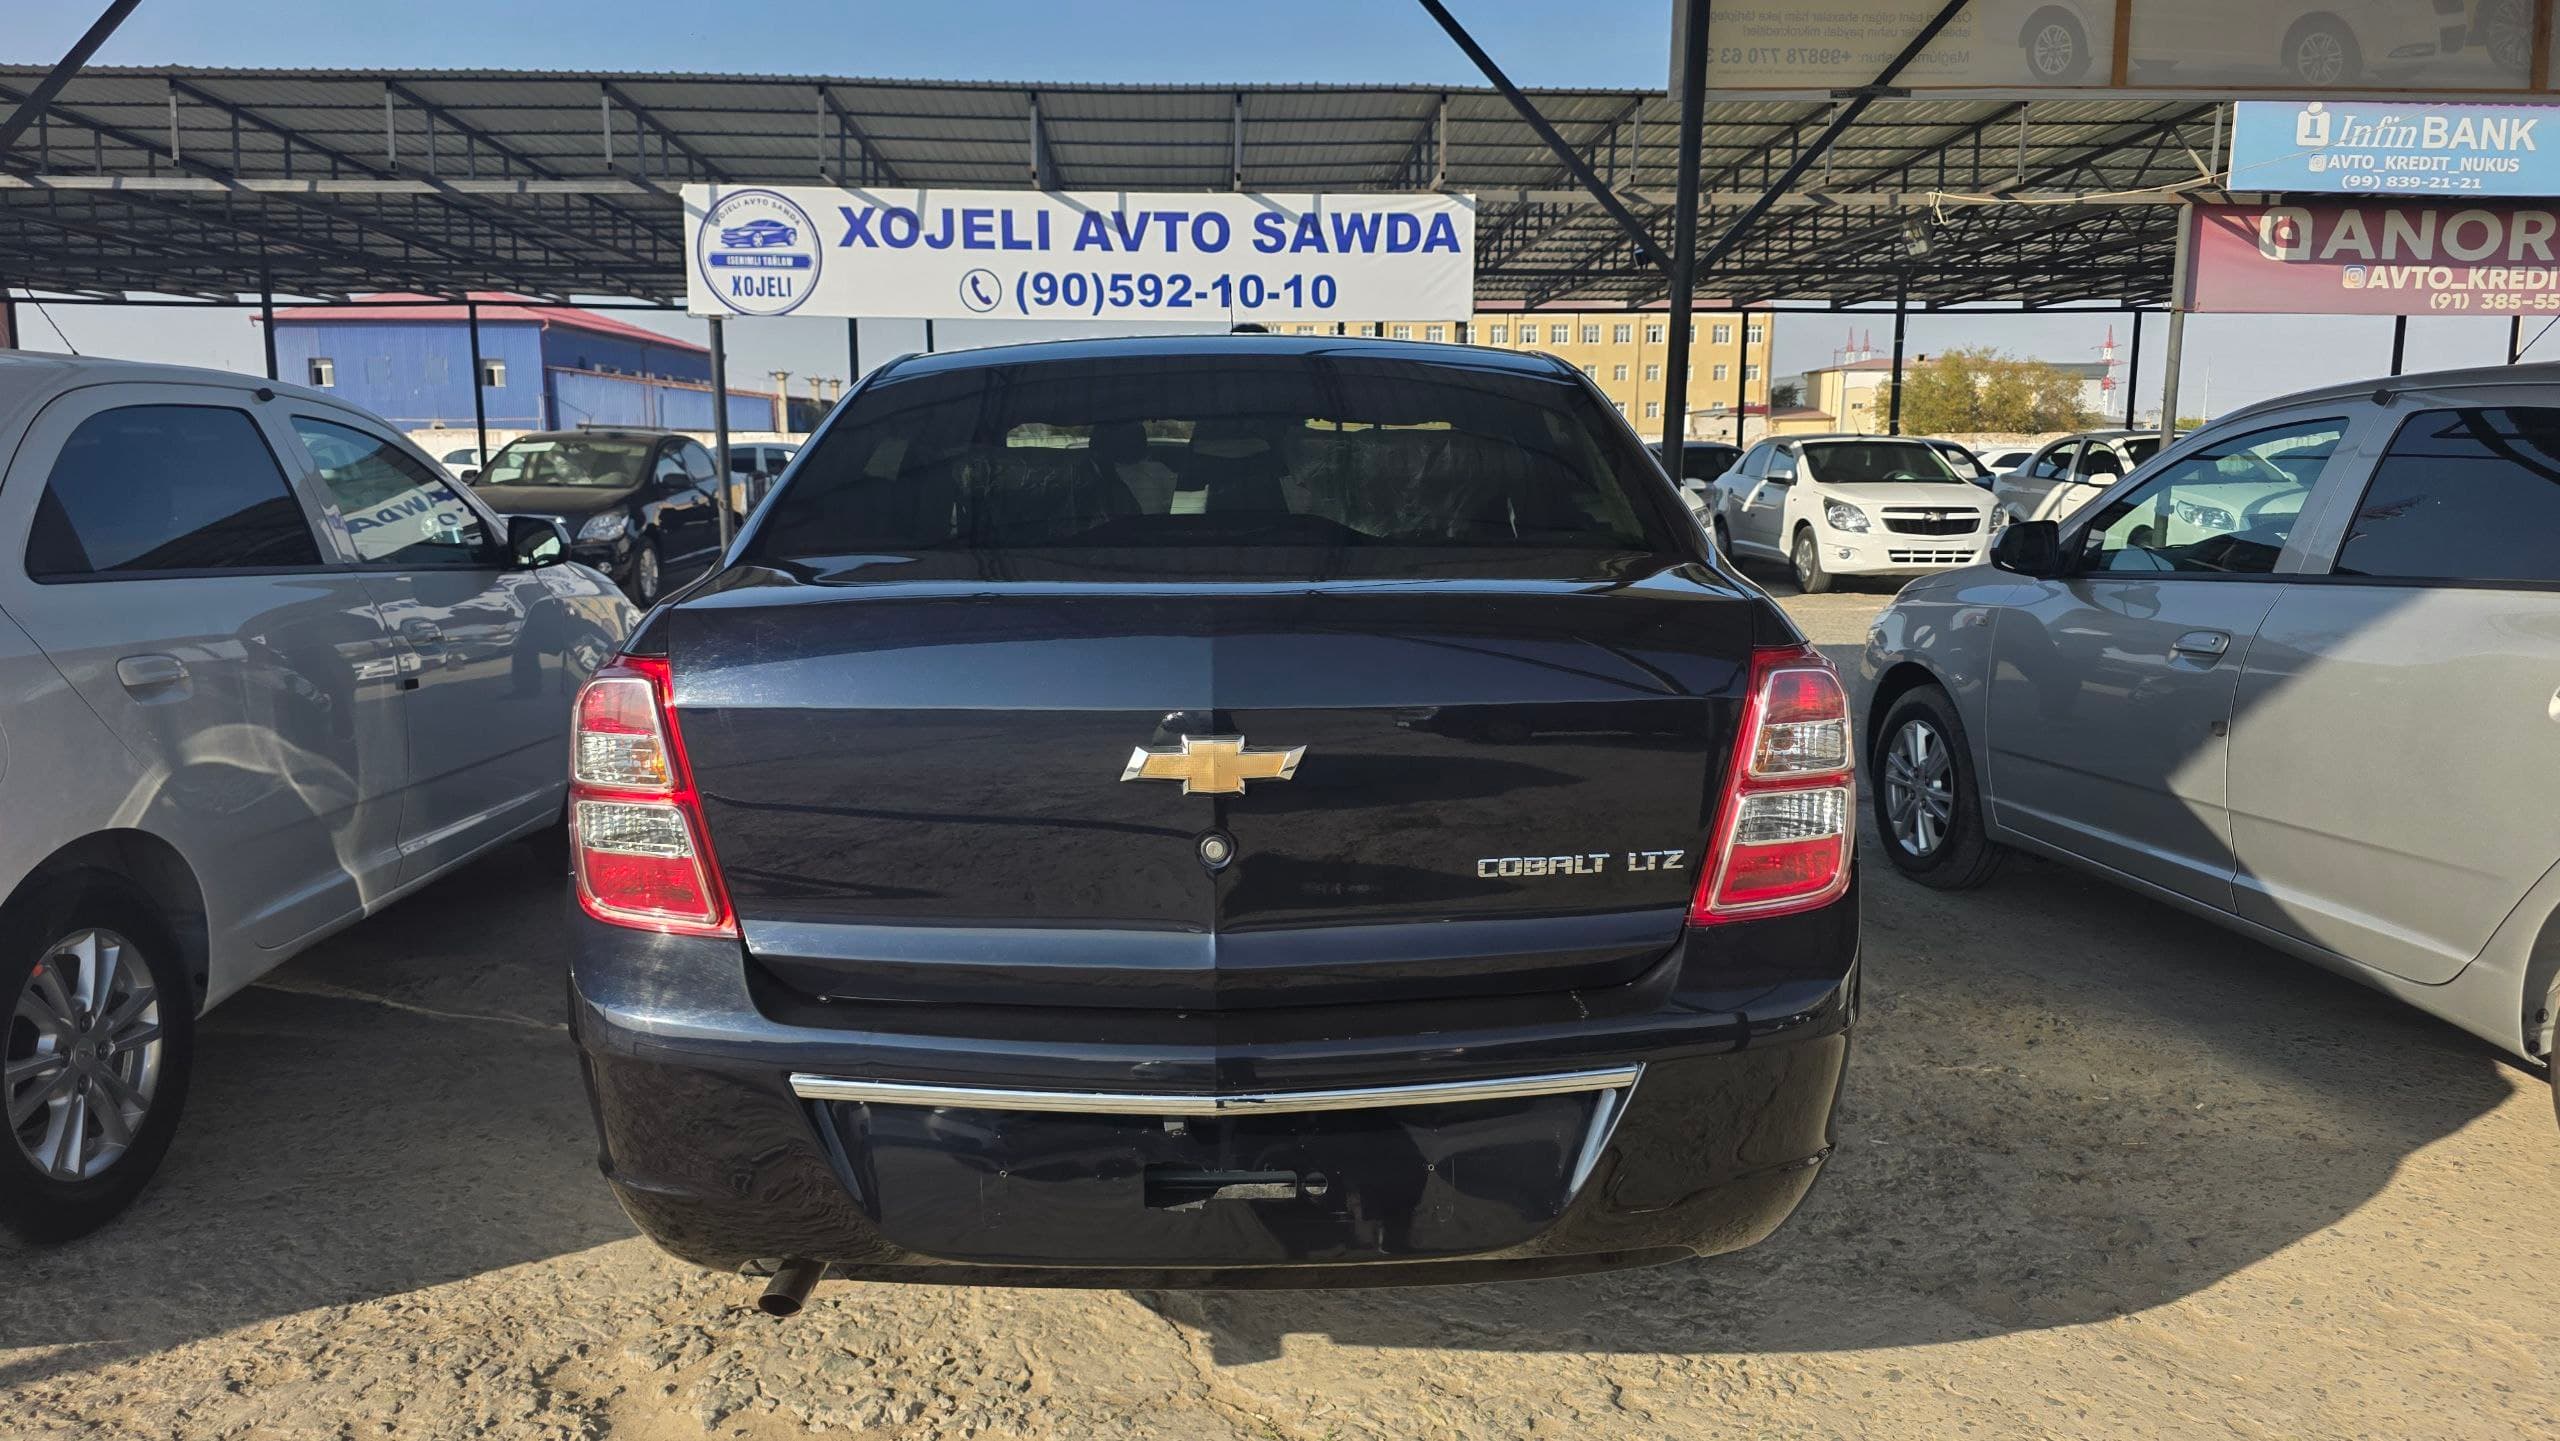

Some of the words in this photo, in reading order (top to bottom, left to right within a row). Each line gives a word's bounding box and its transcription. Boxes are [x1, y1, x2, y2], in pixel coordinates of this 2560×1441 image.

[2327, 154, 2520, 173] AVTO_KREDIT_NUKUS
[2341, 174, 2382, 190] (99)
[2386, 175, 2482, 190] 839-21-21
[837, 206, 1050, 250] XOJELI
[1072, 210, 1231, 253] AVTO
[1252, 211, 1461, 254] SAWDA
[2319, 208, 2557, 262] ANOR
[732, 275, 793, 297] XOJELI
[2366, 265, 2560, 290] AVTO_KREDI
[1016, 271, 1337, 316] (90)592-10-10
[2430, 293, 2470, 310] (91)
[1477, 853, 1611, 878] COBALT
[1627, 849, 1685, 872] LTZ
